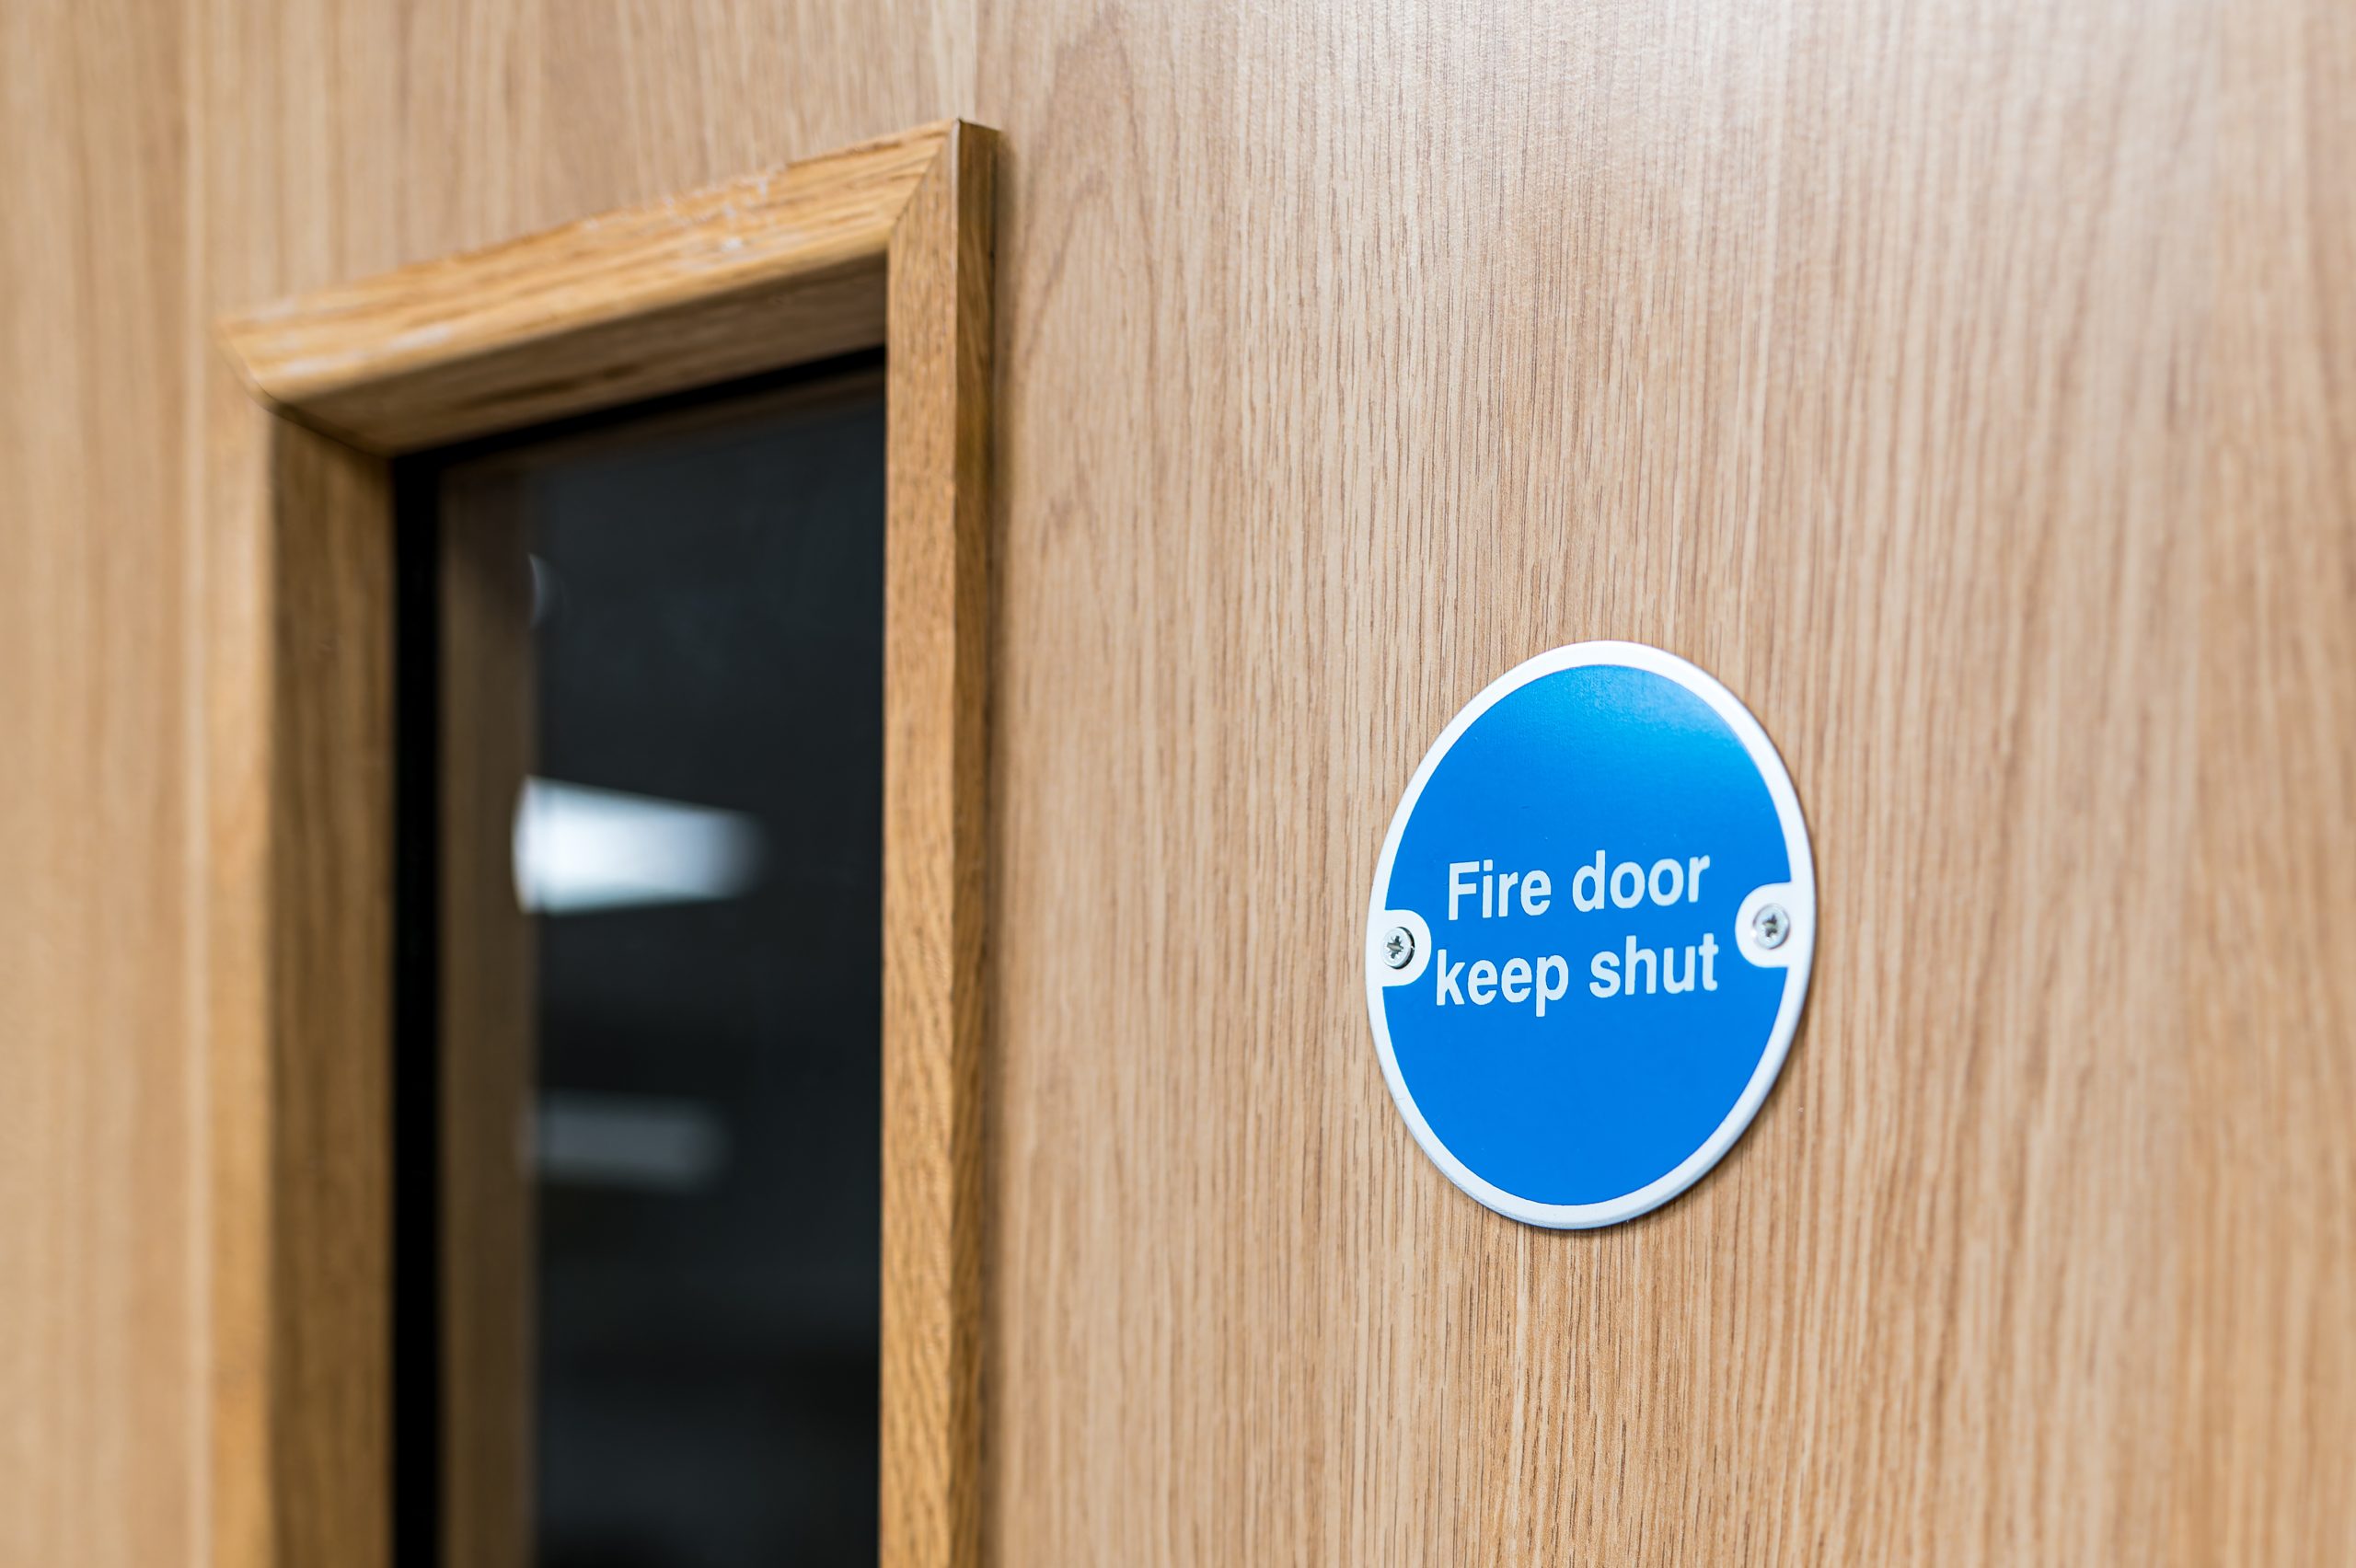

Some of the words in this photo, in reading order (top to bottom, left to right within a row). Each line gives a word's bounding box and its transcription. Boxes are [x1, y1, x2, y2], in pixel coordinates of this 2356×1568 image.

[1448, 859, 1552, 921] Fire
[1572, 849, 1711, 913] door
[1436, 949, 1569, 1018] keep
[1589, 933, 1719, 998] shut
